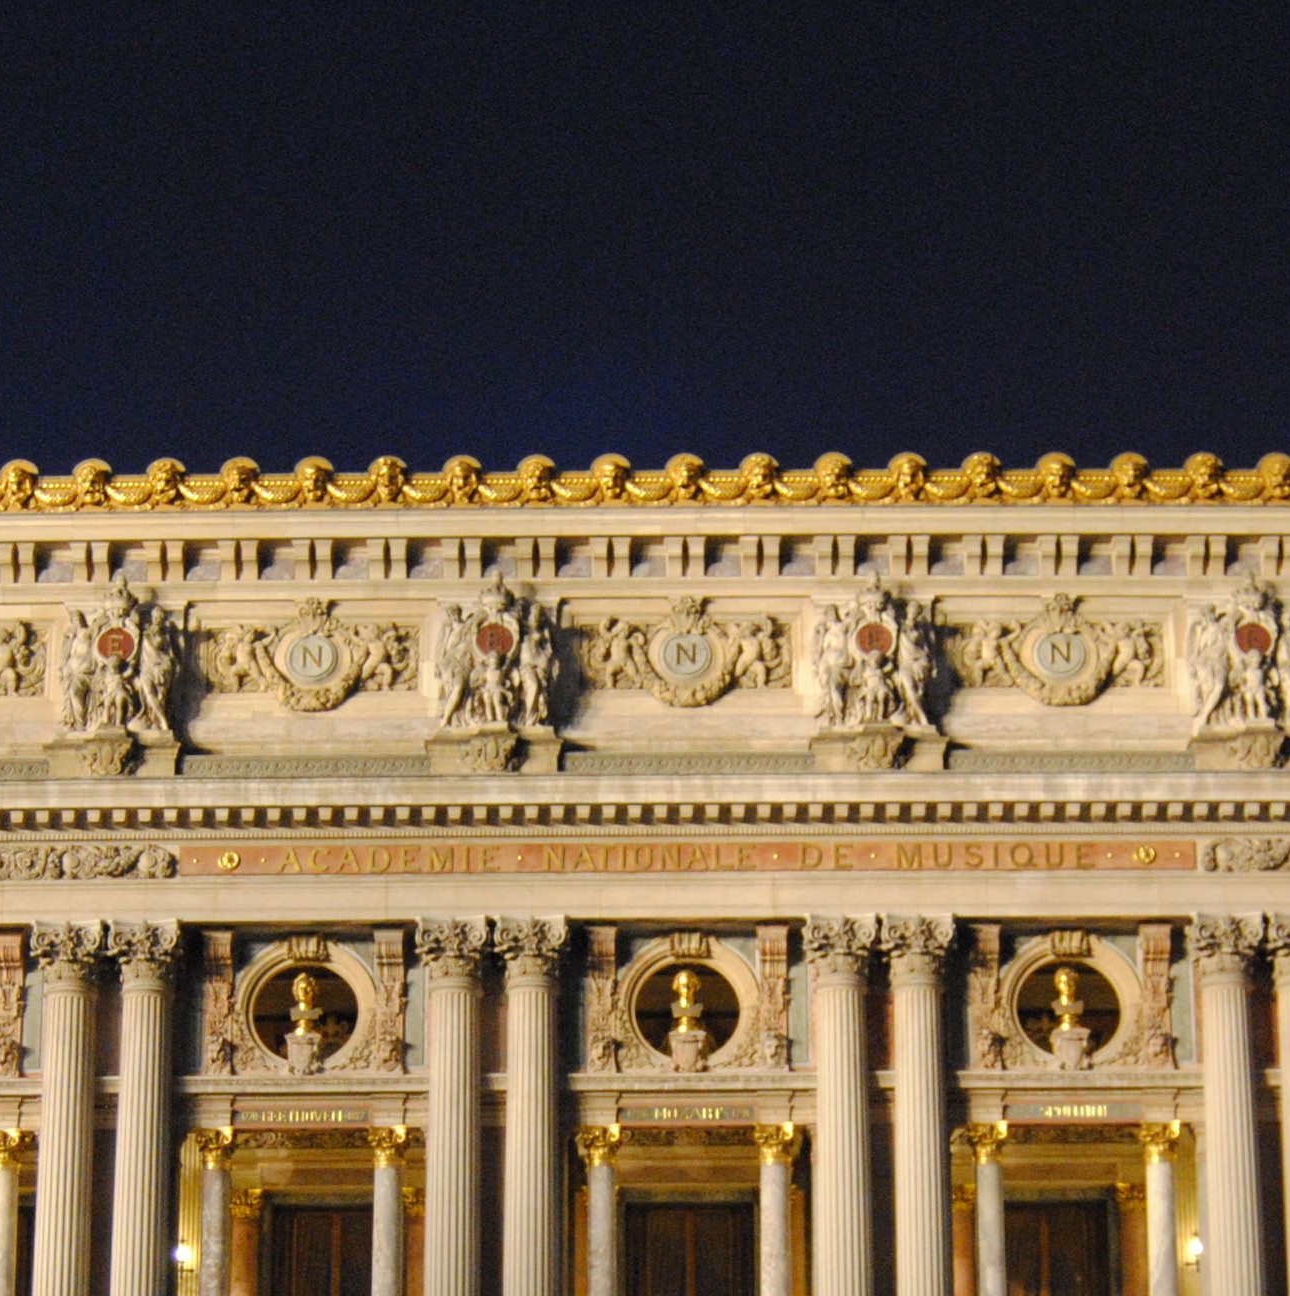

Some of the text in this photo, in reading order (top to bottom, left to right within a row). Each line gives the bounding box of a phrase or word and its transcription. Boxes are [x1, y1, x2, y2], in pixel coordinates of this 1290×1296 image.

[301, 645, 323, 669] N
[675, 642, 697, 665] N
[1049, 641, 1072, 665] N
[279, 842, 1096, 873] ACADEMIE NATIONALE DE MUSIQUE
